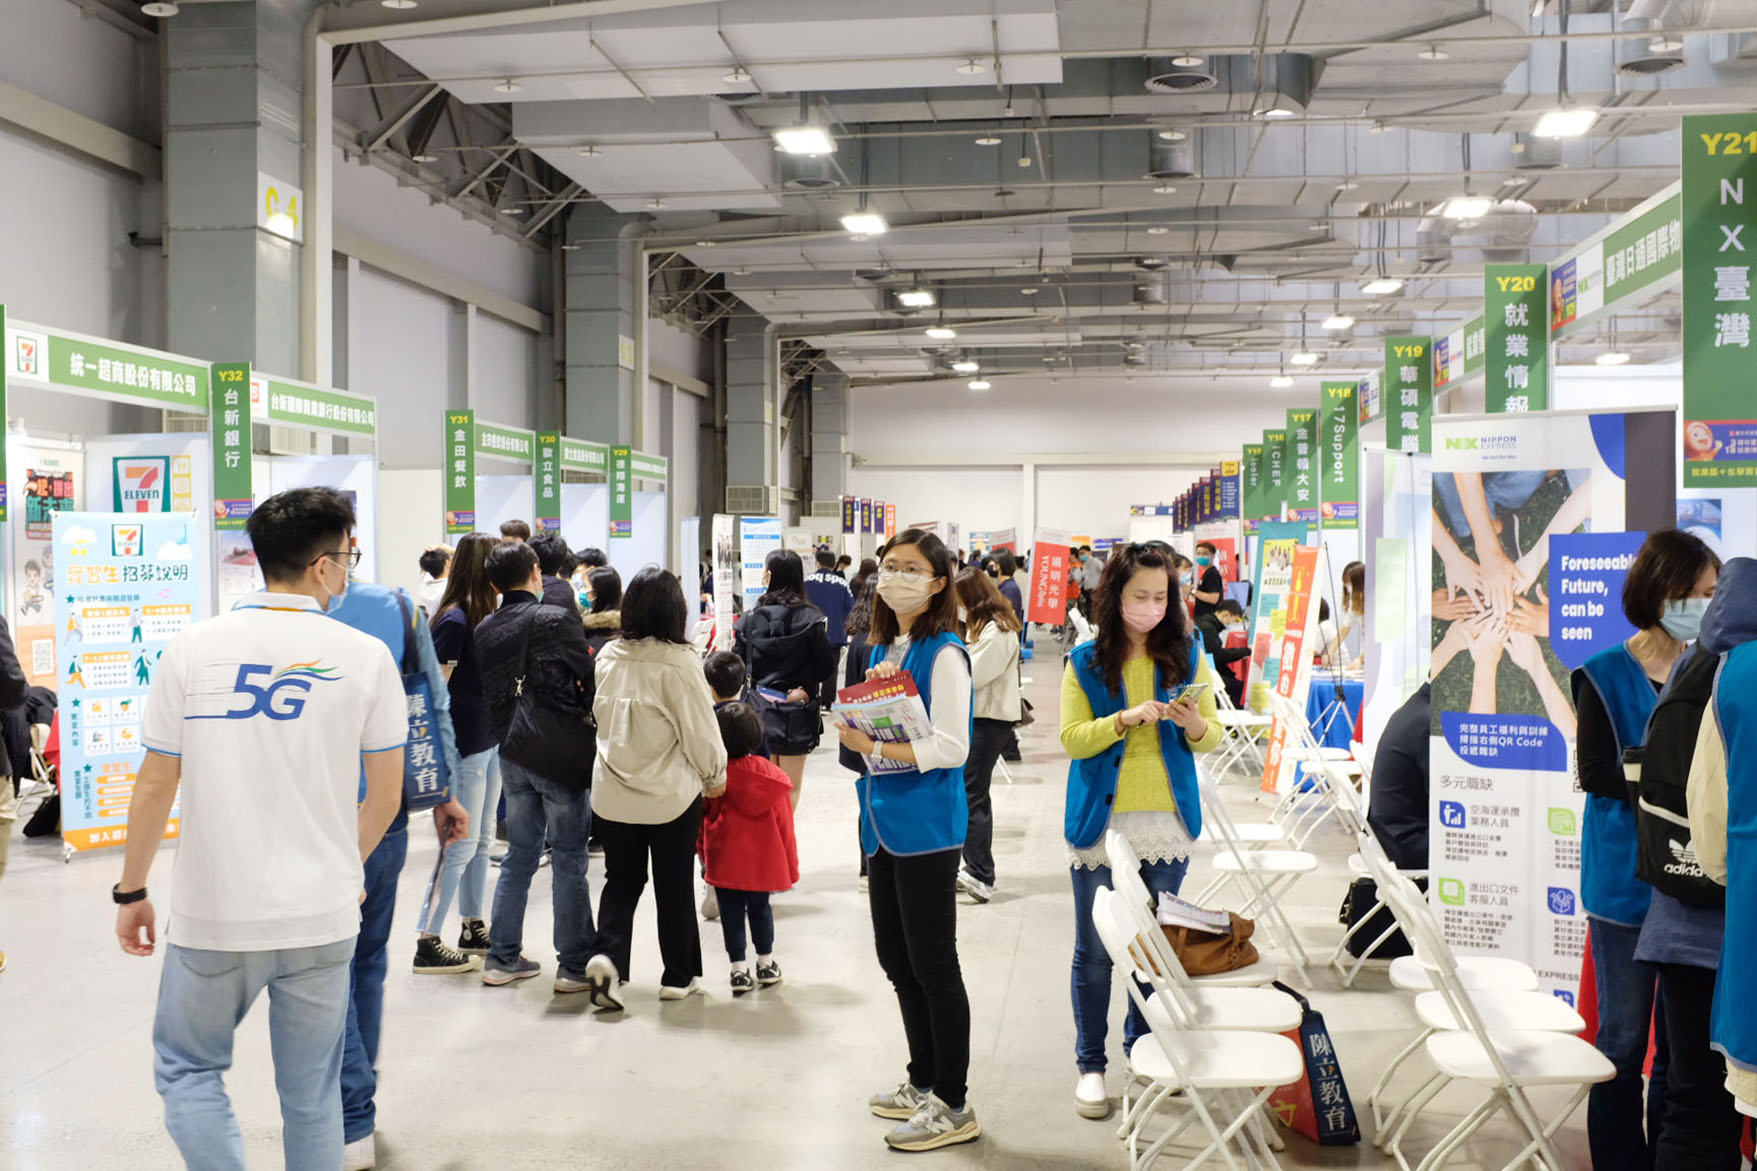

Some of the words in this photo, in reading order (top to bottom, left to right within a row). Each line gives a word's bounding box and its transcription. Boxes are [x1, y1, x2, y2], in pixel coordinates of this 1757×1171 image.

[1700, 131, 1757, 155] Y21
[1714, 177, 1750, 347] NX臺灣
[1496, 276, 1536, 292] Y20
[1394, 345, 1424, 358] Y19
[1504, 303, 1529, 412] 就業情報
[70, 352, 196, 397] 統一超商股份有限公司
[219, 370, 243, 382] Y32
[1328, 388, 1352, 398] Y18
[1292, 414, 1312, 422] Y17
[1400, 366, 1419, 453] 華碩電腦
[224, 388, 240, 468] 台新銀行
[450, 415, 469, 425] Y31
[1332, 406, 1346, 483] 17Support
[1481, 435, 1517, 444] NIPPON
[1561, 578, 1608, 597] Future,
[1561, 604, 1586, 617] can
[1587, 600, 1605, 617] be
[1561, 627, 1592, 640] seen
[225, 663, 312, 720] 5G
[407, 693, 438, 794] 陳立教育
[1516, 737, 1543, 747] Code
[1440, 775, 1494, 791] 多元職缺
[1663, 863, 1705, 878] adida
[1309, 1033, 1347, 1132] 陳立教育
